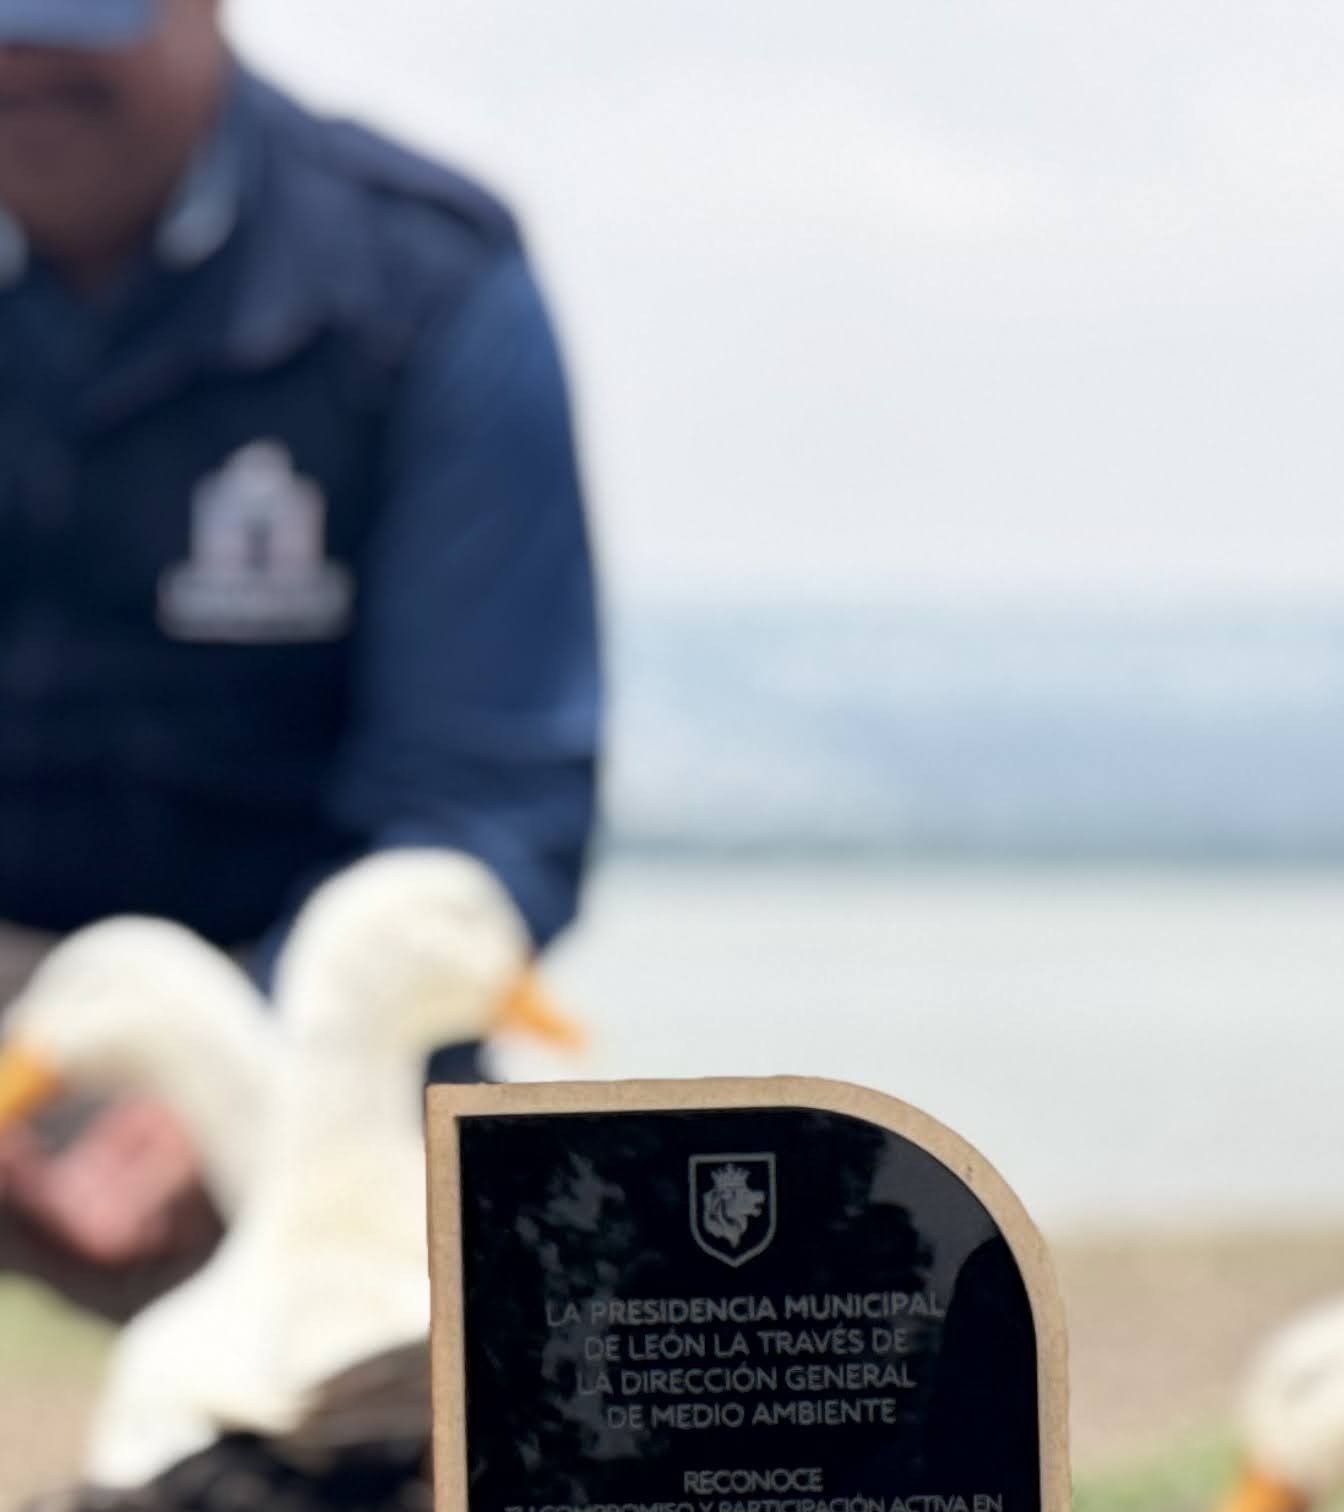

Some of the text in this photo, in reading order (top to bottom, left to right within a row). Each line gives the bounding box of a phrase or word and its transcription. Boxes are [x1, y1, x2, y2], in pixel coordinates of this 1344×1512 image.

[546, 1292, 946, 1326] LA PRESIDENCIA MUNICIPAL
[585, 1323, 908, 1361] DE LEÓN LA TRAVÉS DE
[578, 1363, 916, 1395] LA DIRECCIÓN GENERAL
[608, 1398, 896, 1429] DE MEDIO AMBIENTE
[684, 1467, 823, 1495] RECONOCE
